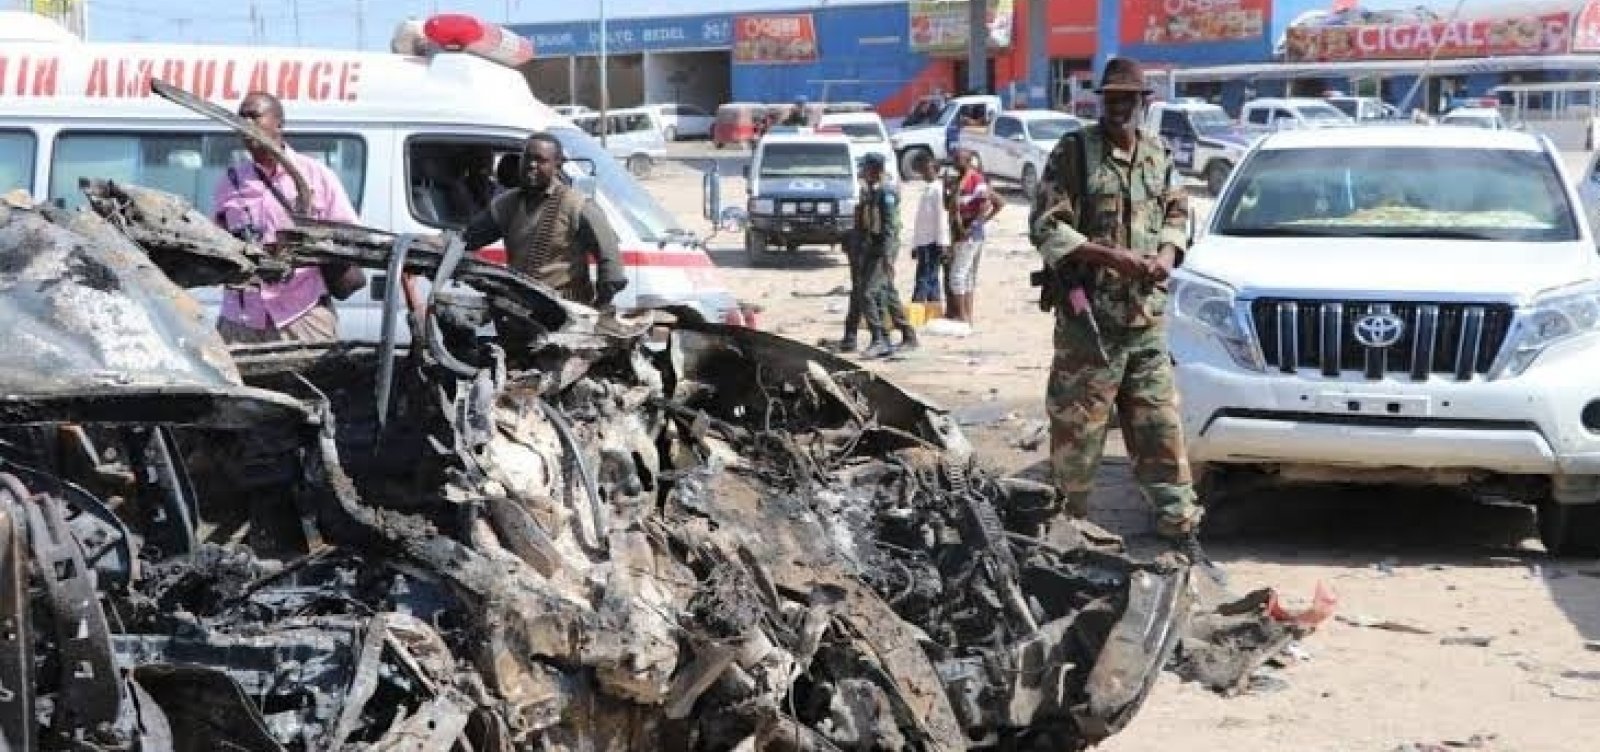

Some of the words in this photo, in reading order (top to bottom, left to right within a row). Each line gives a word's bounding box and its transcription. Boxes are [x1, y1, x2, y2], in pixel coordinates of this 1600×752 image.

[1357, 20, 1485, 50] CIGAAL
[0, 57, 59, 97] IN
[85, 58, 362, 101] AMBULANCE
